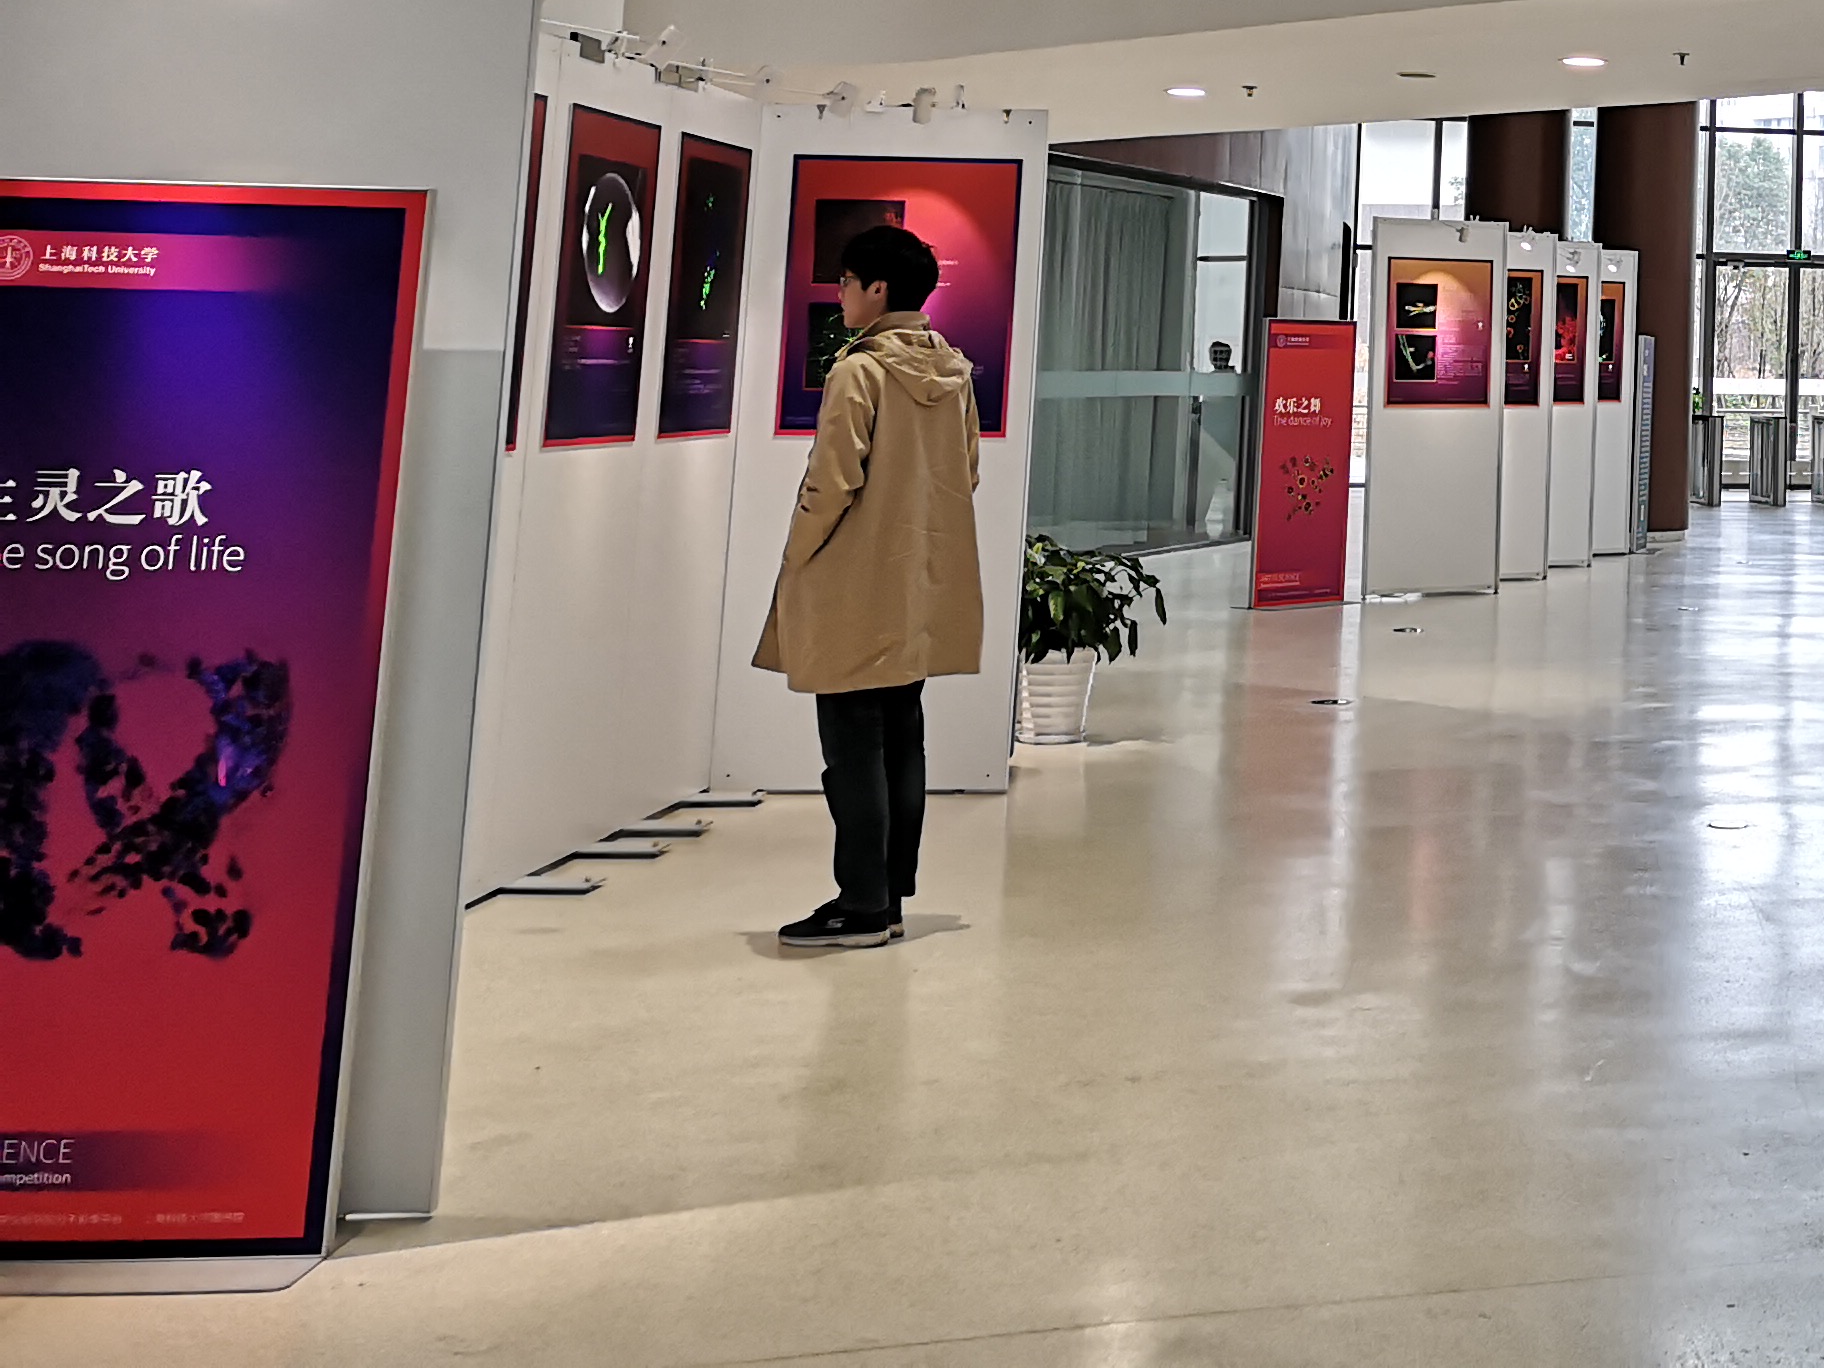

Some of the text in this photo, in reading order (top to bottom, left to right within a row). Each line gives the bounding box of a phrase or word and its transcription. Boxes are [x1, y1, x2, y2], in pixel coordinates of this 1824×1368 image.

[40, 244, 160, 263] 上海科技大学
[38, 263, 156, 276] ShanghaiTech University
[1288, 414, 1311, 426] dance
[34, 543, 133, 581] song
[140, 534, 183, 571] of
[189, 534, 246, 572] life
